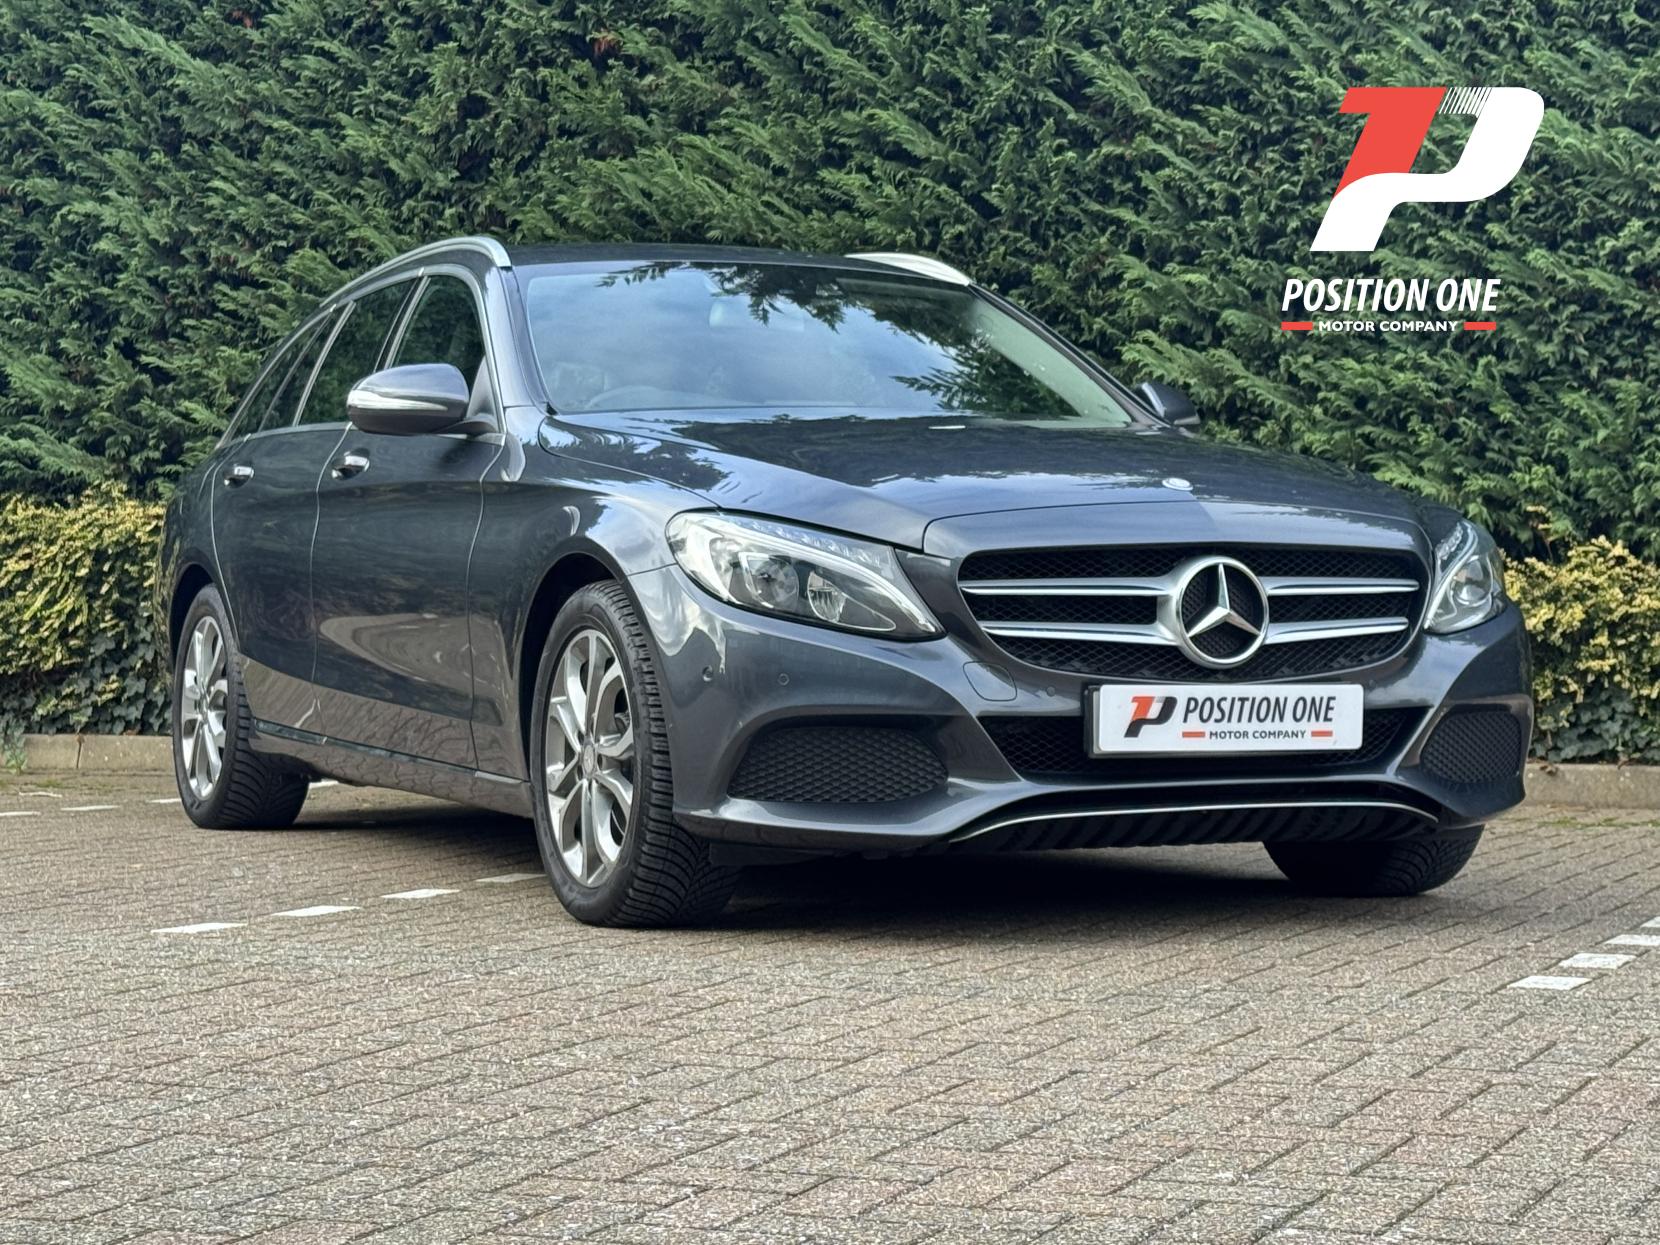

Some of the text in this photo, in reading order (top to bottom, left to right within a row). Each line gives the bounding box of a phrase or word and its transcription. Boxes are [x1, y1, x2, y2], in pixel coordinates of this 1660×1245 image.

[1182, 696, 1337, 723] POSITION ONE
[1209, 730, 1307, 740] MOTOR COMPANY
